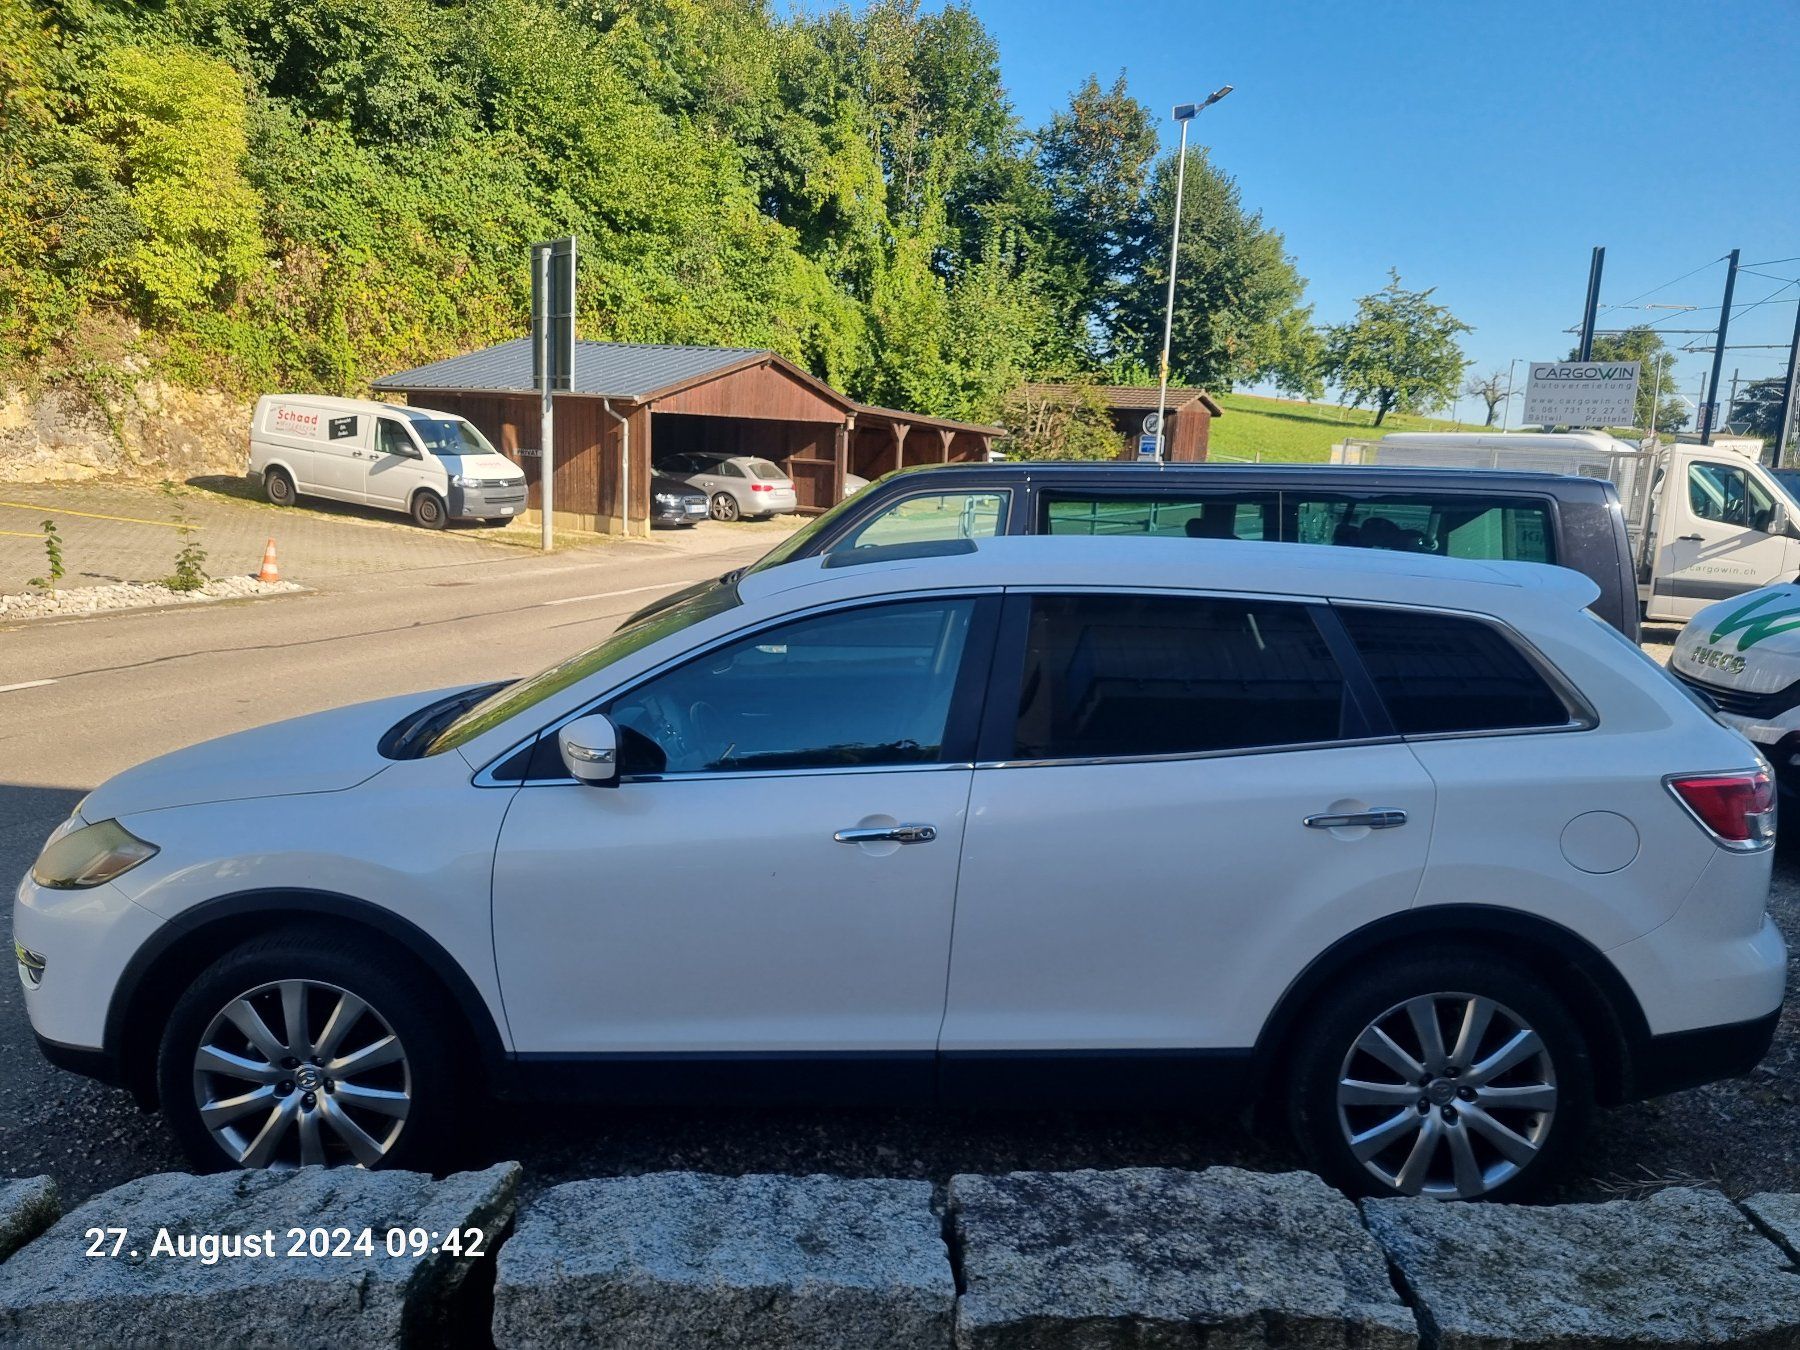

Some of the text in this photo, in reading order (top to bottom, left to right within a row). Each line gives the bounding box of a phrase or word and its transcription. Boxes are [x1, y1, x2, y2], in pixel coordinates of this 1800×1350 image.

[1534, 367, 1634, 381] CARGOWIN
[1533, 382, 1632, 390] Autovermietung
[277, 409, 319, 425] Schaad
[1689, 566, 1757, 576] cargowin.ch
[1691, 646, 1747, 675] IVECO
